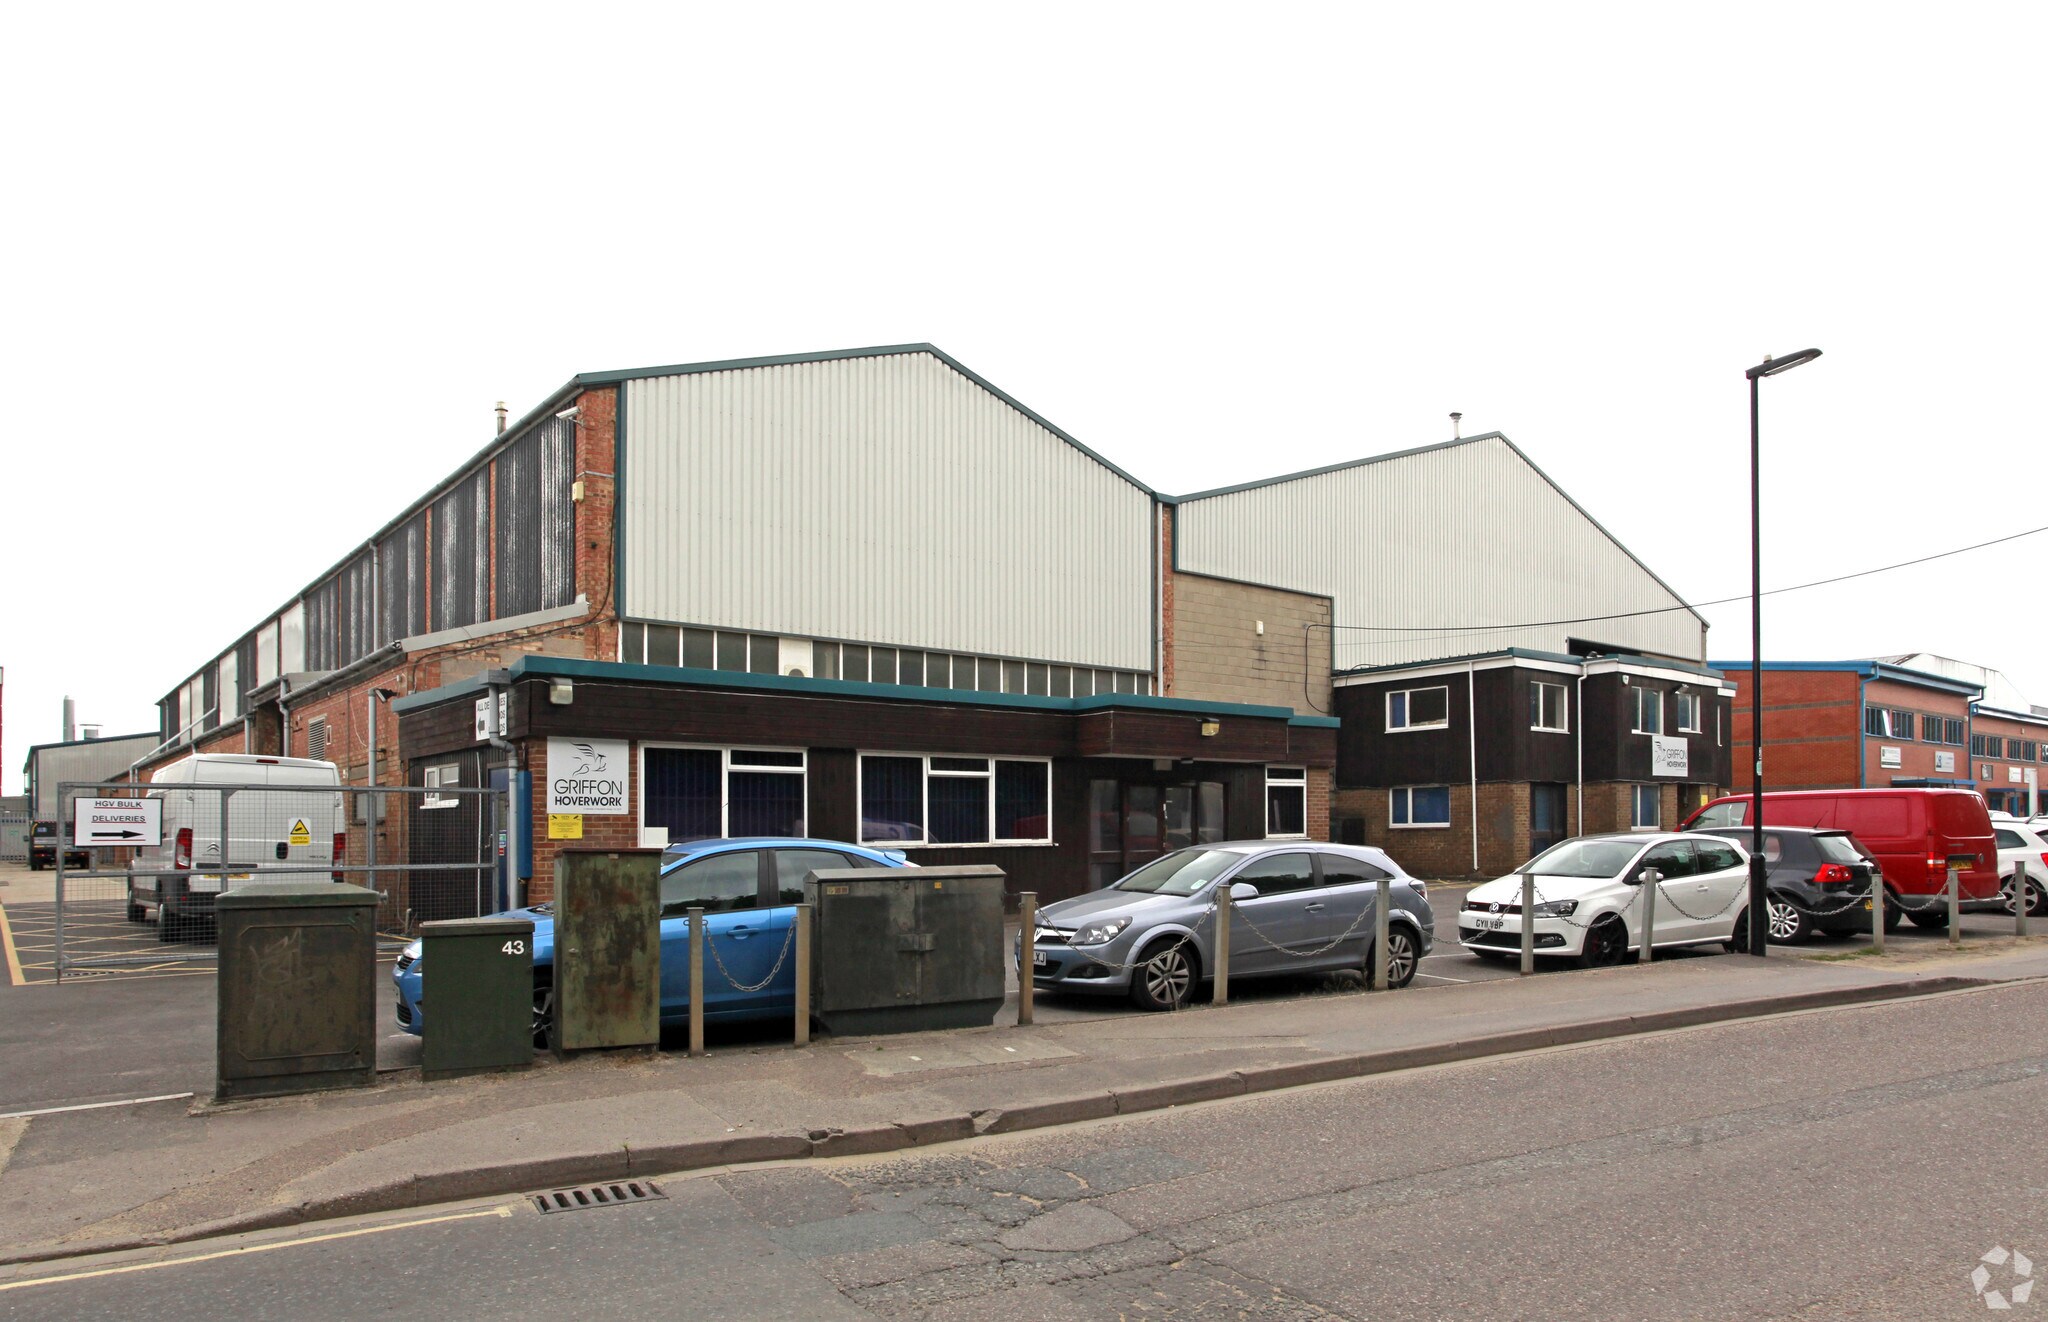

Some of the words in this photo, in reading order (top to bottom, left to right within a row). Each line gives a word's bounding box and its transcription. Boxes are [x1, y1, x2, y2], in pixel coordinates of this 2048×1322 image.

[554, 778, 623, 795] GRIFFON
[554, 795, 622, 807] HOVERWORK
[501, 940, 525, 955] 43
